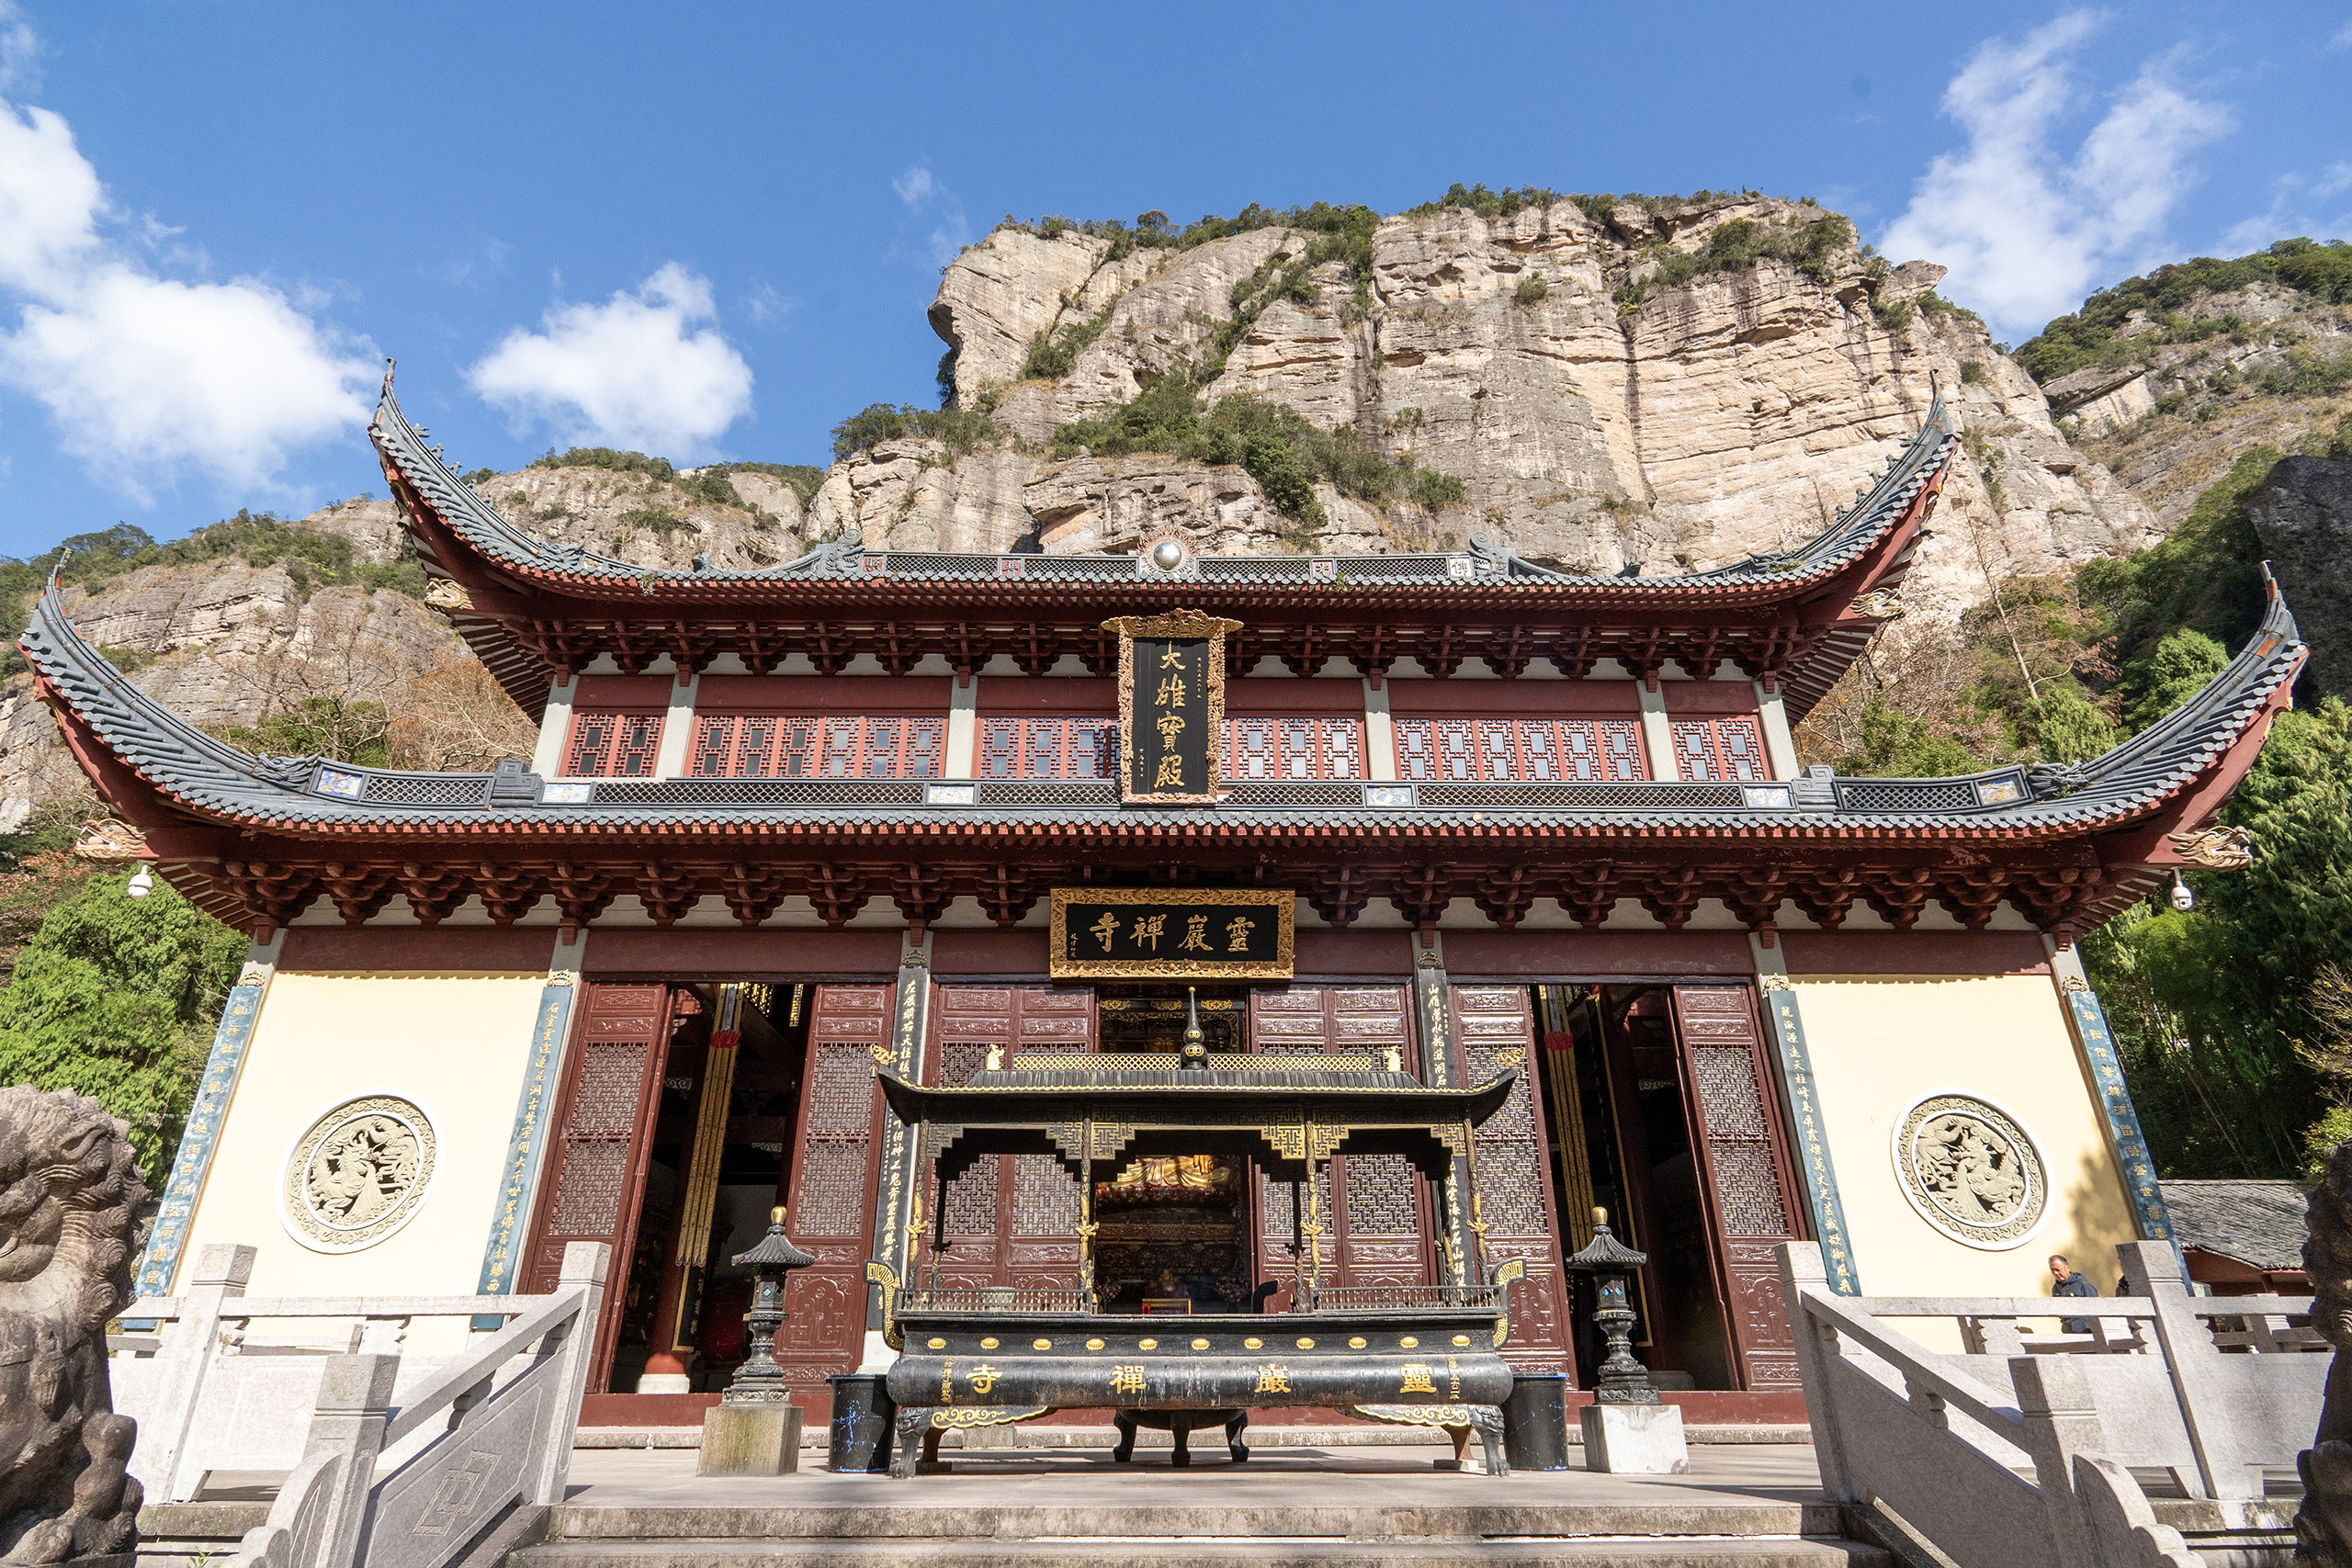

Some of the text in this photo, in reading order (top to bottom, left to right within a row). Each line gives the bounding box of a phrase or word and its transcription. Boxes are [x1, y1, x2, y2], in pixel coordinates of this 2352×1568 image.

[1154, 640, 1186, 789] 大雄寶殿
[1090, 912, 1256, 953] 靈巖禪寺
